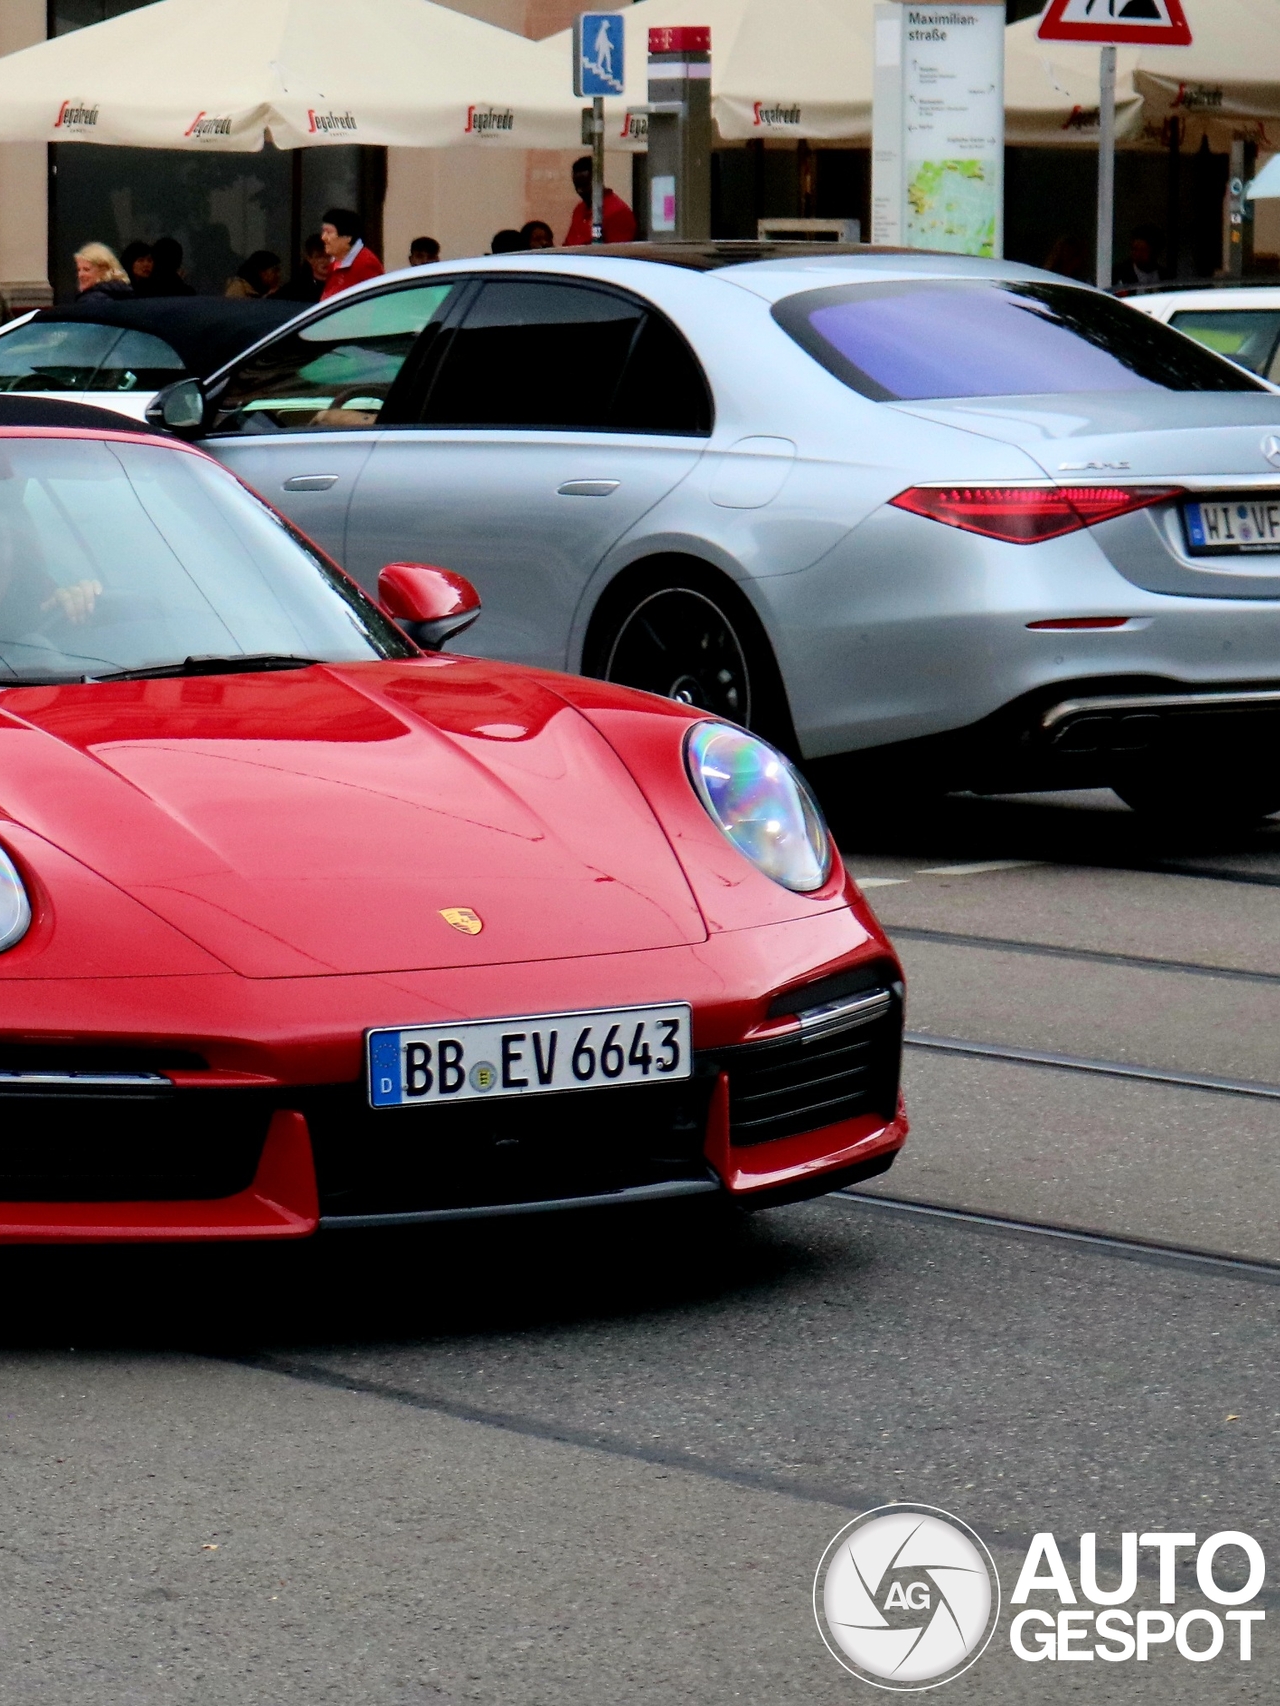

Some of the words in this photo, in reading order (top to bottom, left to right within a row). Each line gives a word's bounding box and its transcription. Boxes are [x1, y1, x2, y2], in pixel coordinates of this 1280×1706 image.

[909, 12, 978, 25] Maximilian-
[661, 29, 673, 49] T
[909, 28, 947, 41] straße
[54, 100, 100, 128] Segafredo
[308, 109, 357, 134] Segafredo
[464, 105, 514, 133] Segafredo
[405, 1038, 466, 1097] BB
[502, 1028, 558, 1088] EV
[572, 1017, 680, 1081] 6643
[381, 1077, 393, 1094] D
